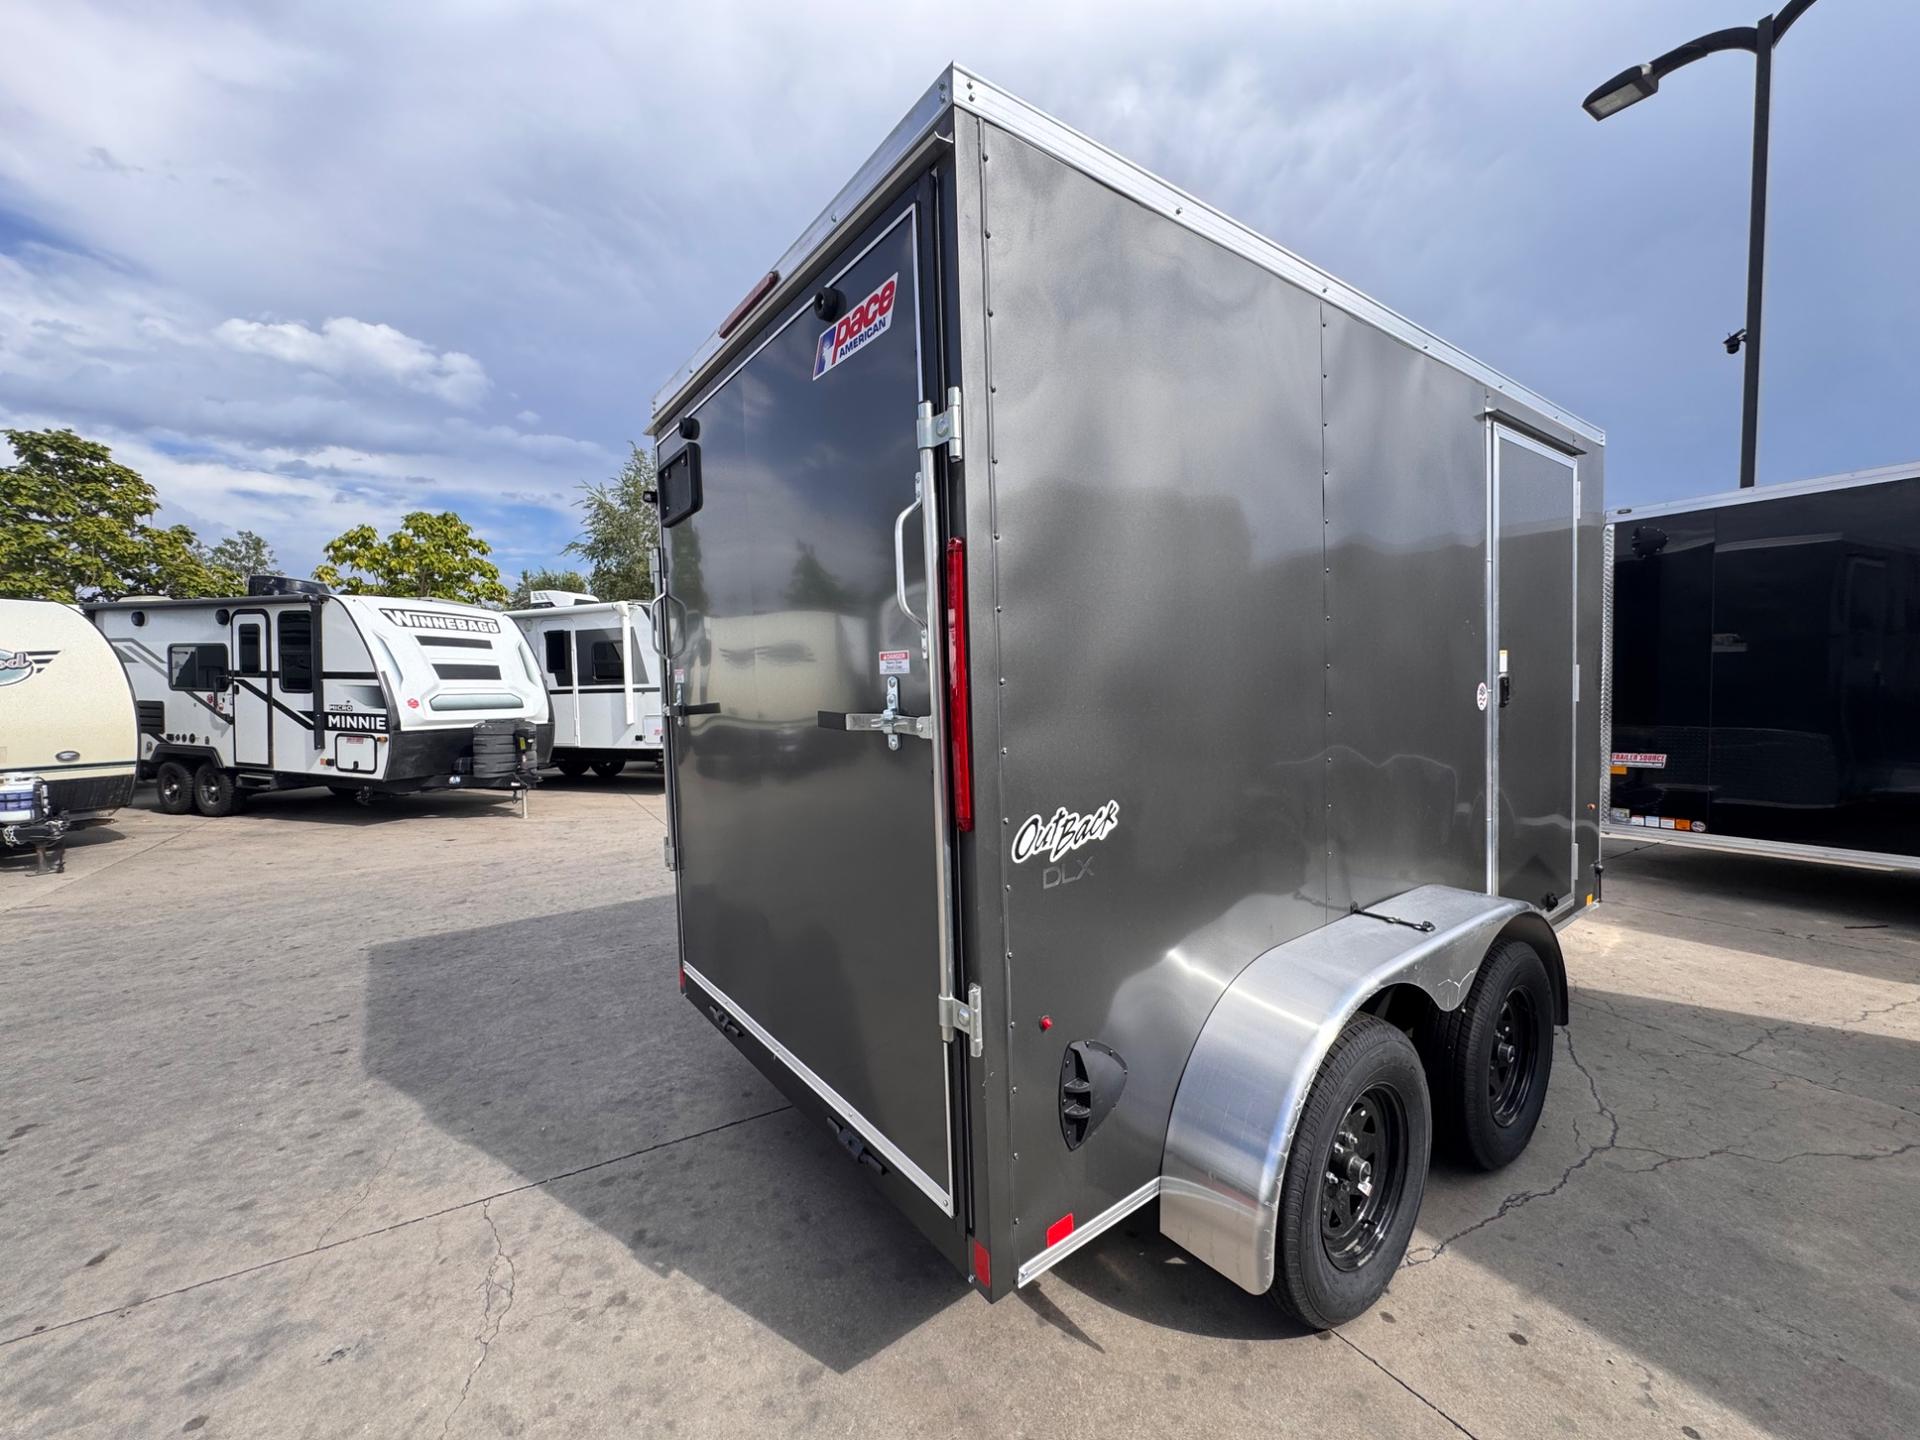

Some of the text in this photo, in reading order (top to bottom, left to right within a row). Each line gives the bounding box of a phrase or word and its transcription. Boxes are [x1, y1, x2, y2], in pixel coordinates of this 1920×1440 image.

[831, 280, 895, 366] pace
[839, 317, 886, 358] AMERICAN
[379, 608, 500, 634] WINNEBAGO
[327, 715, 386, 730] MINNIE
[1639, 754, 1665, 762] SOURCE
[1043, 856, 1095, 889] DLX
